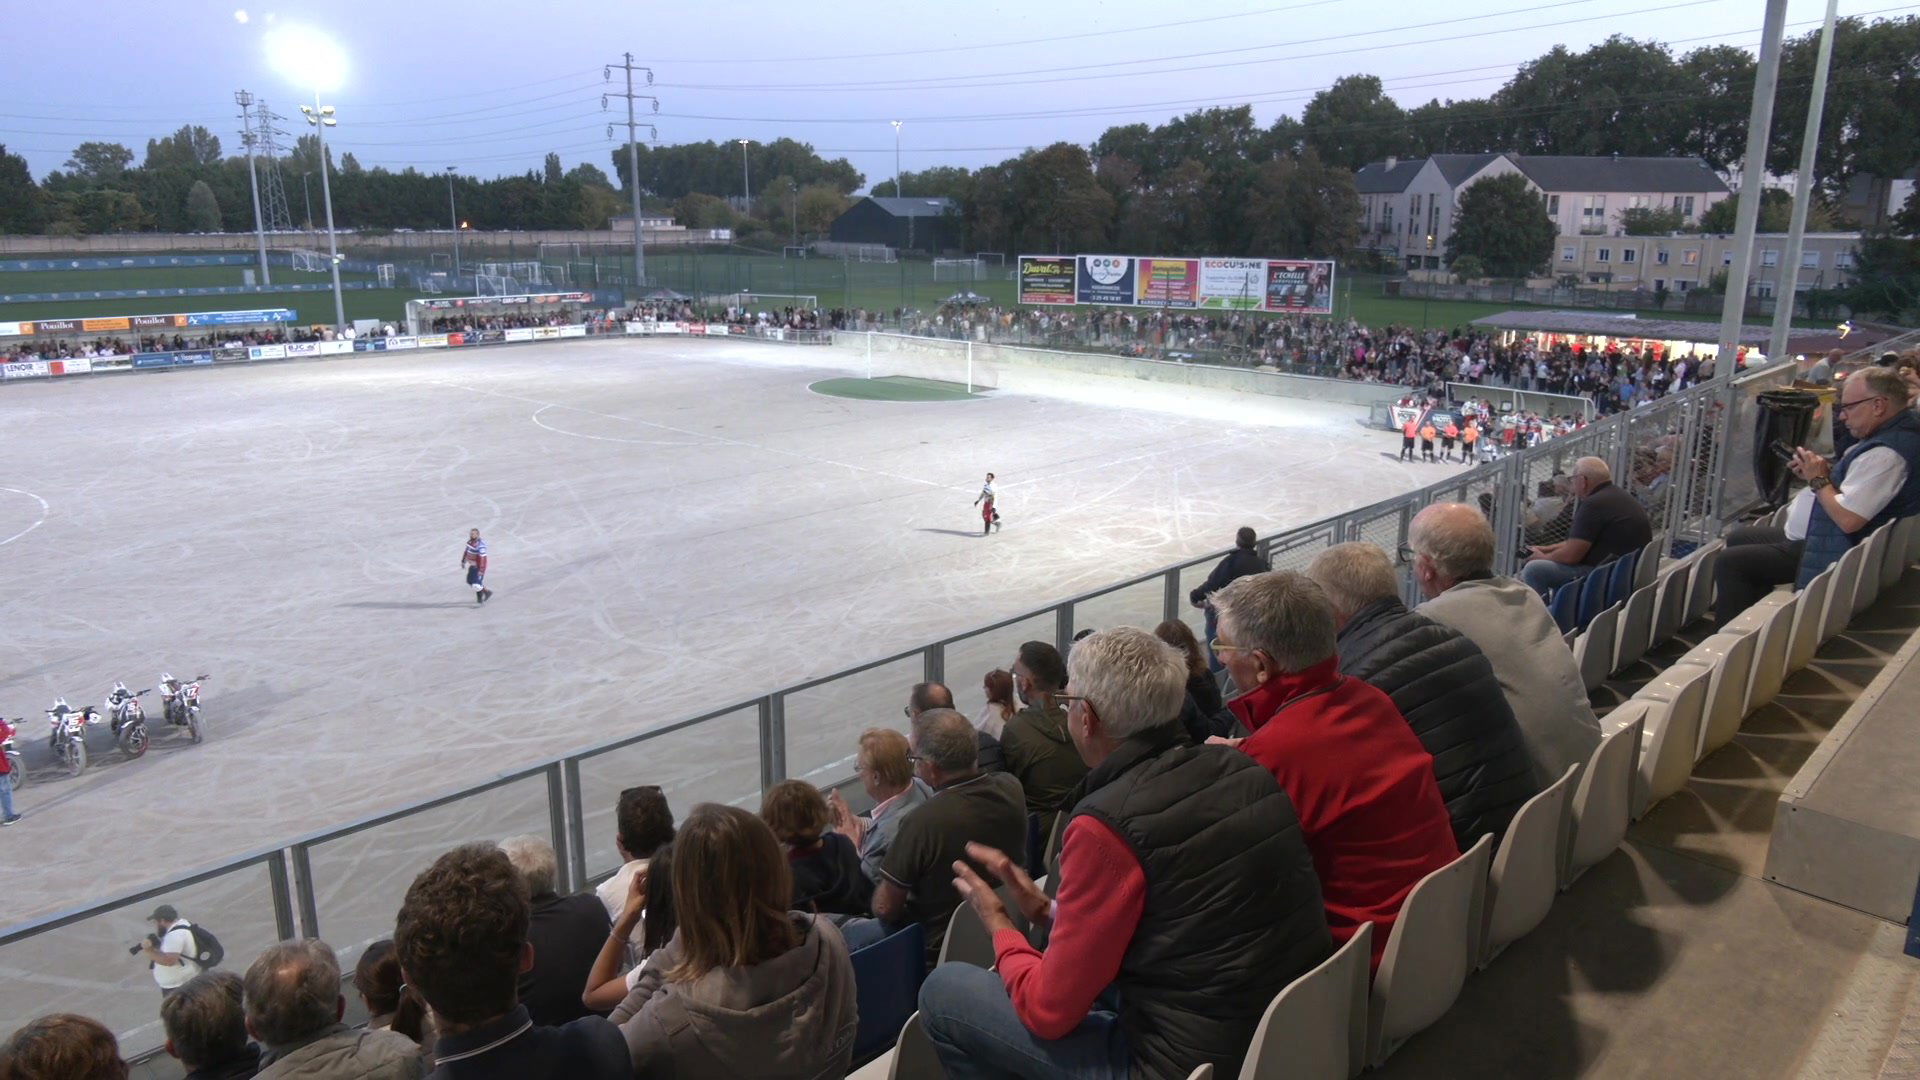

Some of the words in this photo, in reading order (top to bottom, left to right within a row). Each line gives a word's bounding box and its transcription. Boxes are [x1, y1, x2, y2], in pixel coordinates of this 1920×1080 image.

[134, 316, 166, 325] Pouillot
[40, 321, 75, 330] Pouillot
[6, 363, 34, 372] LENOIR
